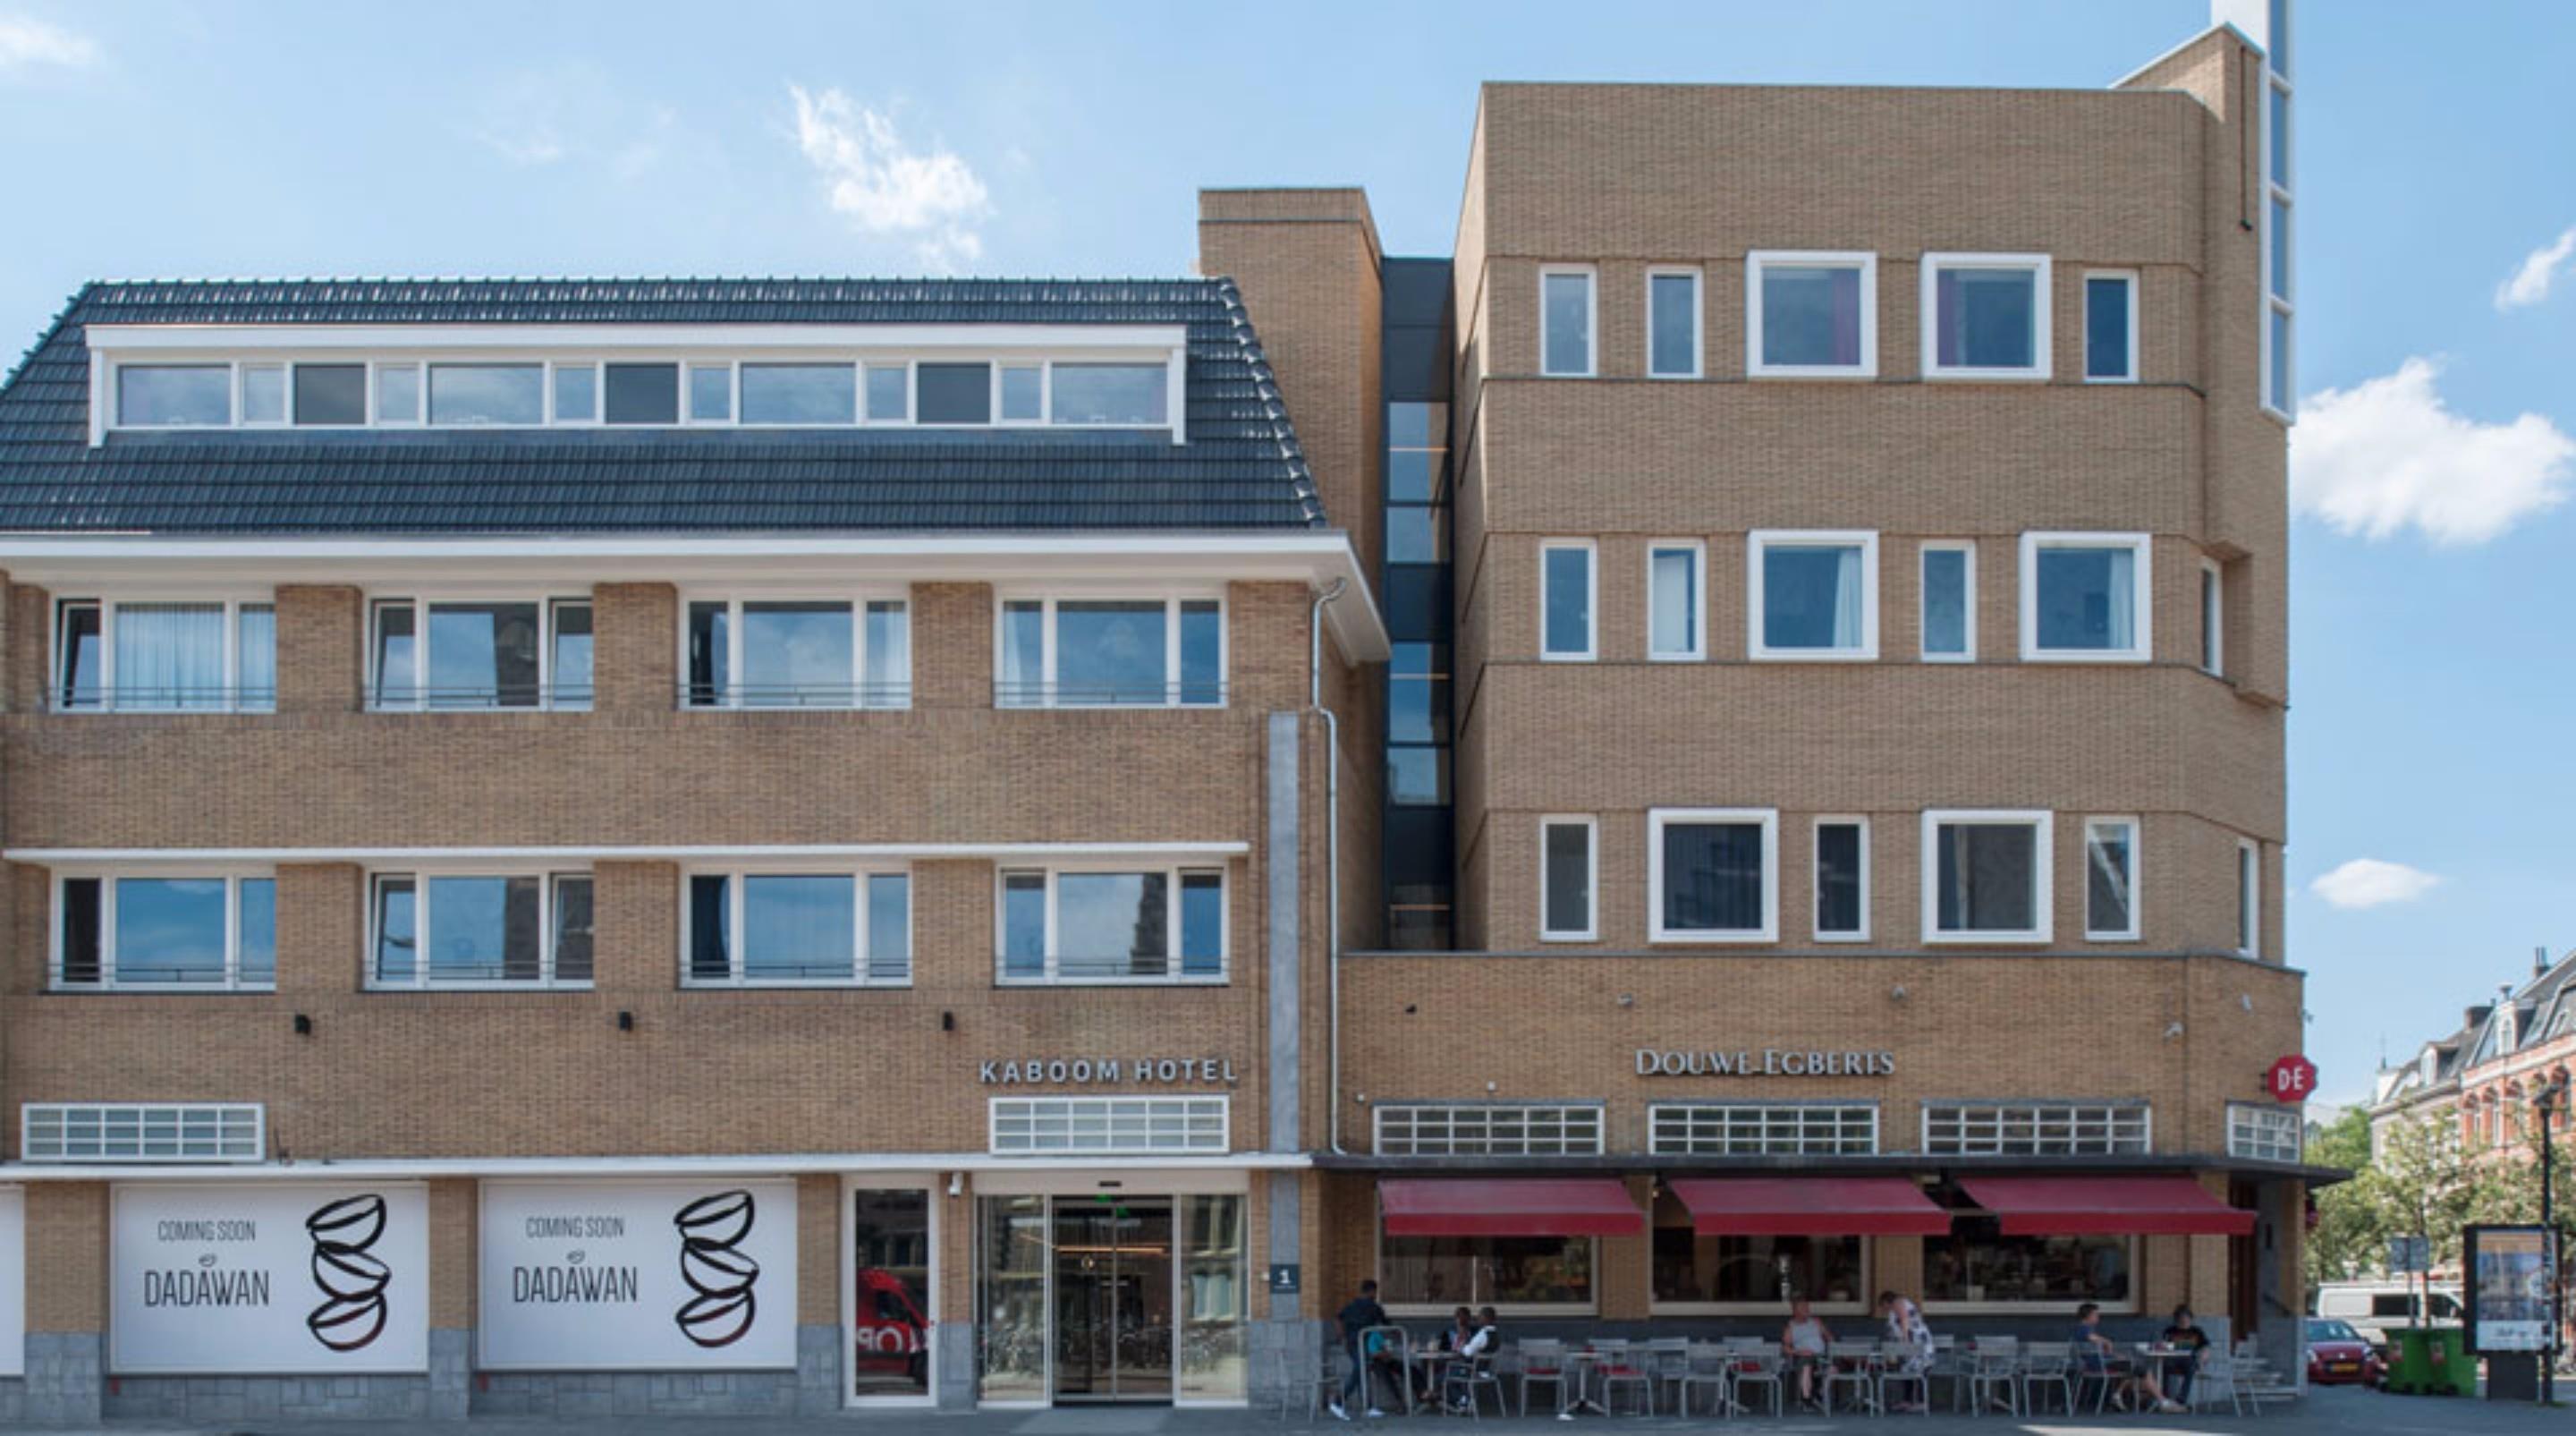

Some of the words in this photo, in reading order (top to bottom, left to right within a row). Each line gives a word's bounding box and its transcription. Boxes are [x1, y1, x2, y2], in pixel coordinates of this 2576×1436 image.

[979, 1059, 1120, 1083] KABOOM
[1134, 1059, 1239, 1082] HOTEL
[1635, 1048, 1751, 1075] DOUWE
[1764, 1048, 1895, 1075] EGBERTS
[157, 1219, 216, 1241] COMING
[217, 1219, 256, 1241] SOON
[526, 1216, 583, 1238] COMING
[585, 1216, 624, 1238] SOON
[144, 1269, 269, 1307] DADAWAN
[513, 1265, 638, 1303] DADAWAN
[1279, 1269, 1291, 1284] 1
